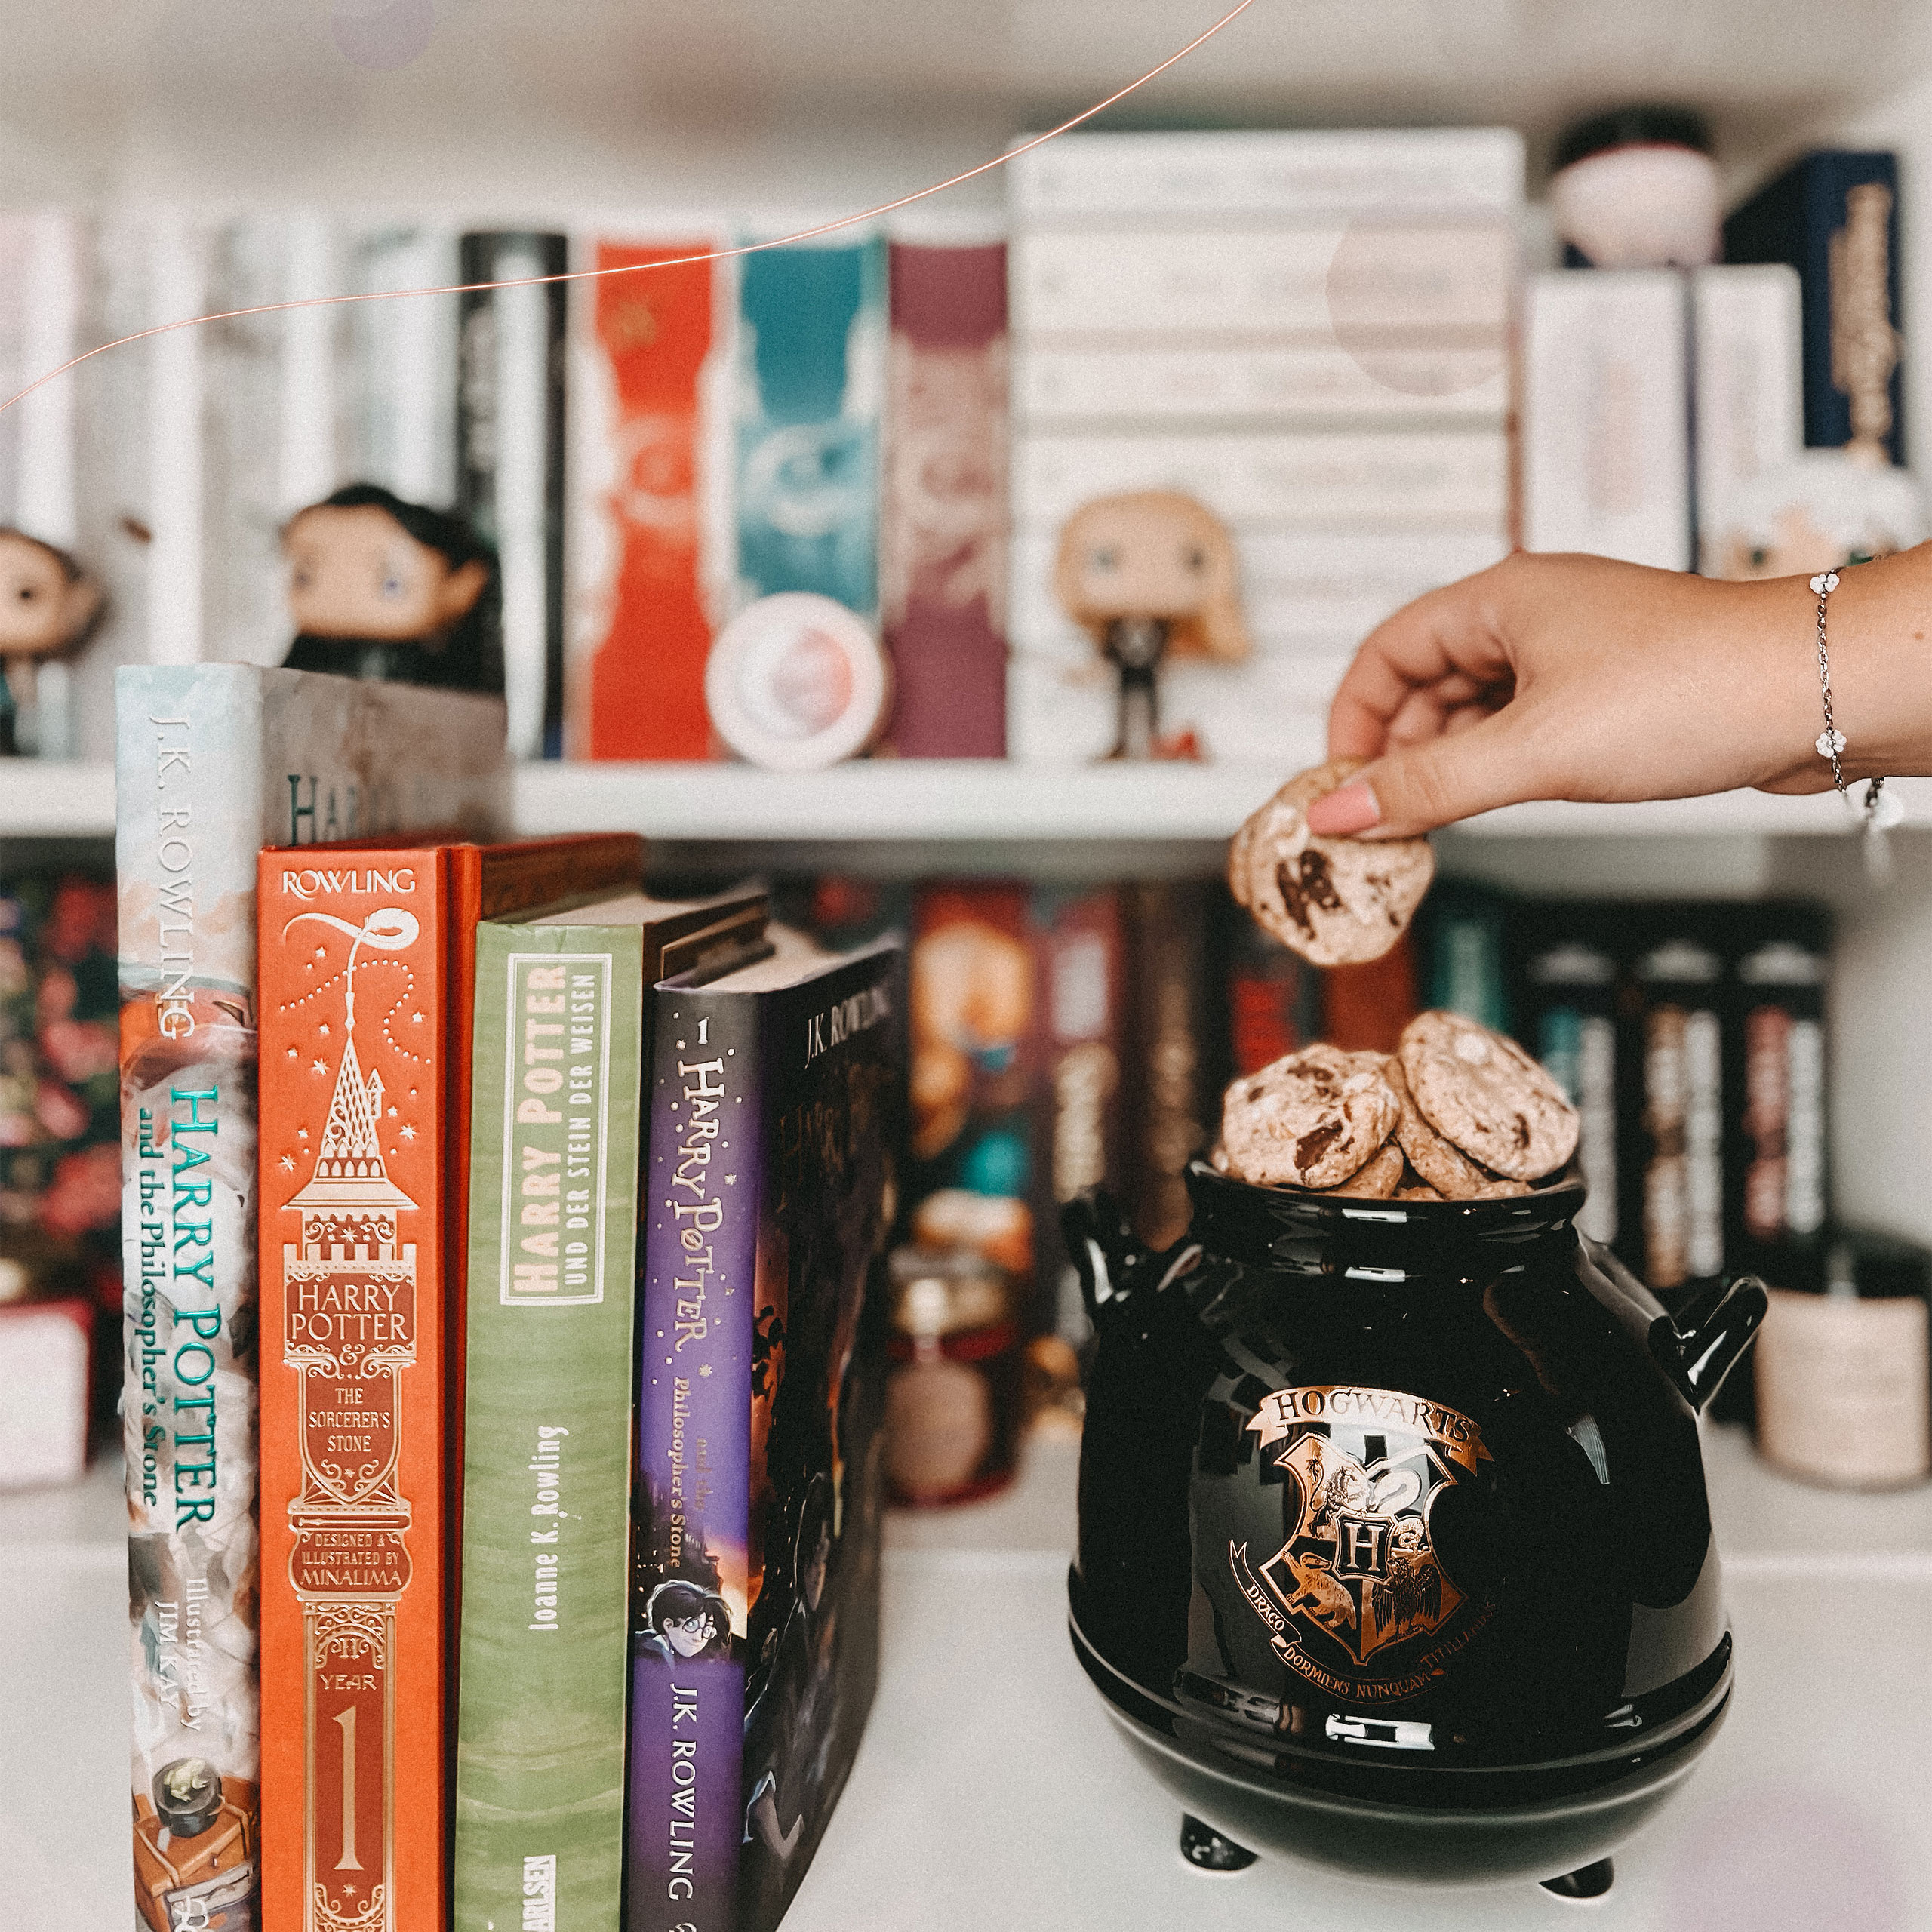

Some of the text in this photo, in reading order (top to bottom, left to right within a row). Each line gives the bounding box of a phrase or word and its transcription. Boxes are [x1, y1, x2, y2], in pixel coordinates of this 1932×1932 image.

[149, 714, 195, 1041] J.K. ROWLING
[282, 869, 416, 900] ROWLING
[696, 1017, 709, 1044] 1
[513, 965, 567, 1292] HARRY POTTER
[565, 974, 595, 1285] UND DER STEIN DER WEISEN
[672, 1057, 725, 1352] HARRY POTTER
[134, 1107, 167, 1507] and the Philosopher's Stone
[171, 1084, 222, 1534] HARRY POTTER
[291, 1313, 409, 1340] POTTER
[299, 1284, 401, 1311] HARRY
[339, 1343, 365, 1366] &
[308, 1411, 391, 1429] SORCERER'S
[334, 1388, 364, 1404] THE
[1272, 1389, 1473, 1442] HOGWARTS
[327, 1435, 371, 1452] STONE
[528, 1425, 570, 1516] Rowling
[667, 1376, 691, 1569] Philosopher's Stone
[694, 1438, 713, 1512] and the
[302, 1551, 399, 1565] ILLUSTRATED BY
[315, 1533, 373, 1547] DESIGNED
[529, 1521, 559, 1544] K.
[300, 1568, 403, 1586] MINALIMA
[154, 1601, 180, 1709] JIM KAY
[180, 1577, 209, 1732] Illustrated by
[1247, 1584, 1284, 1631] DRACO
[1283, 1645, 1351, 1696] DORMIENS
[1356, 1672, 1432, 1698] NUNQUAM
[319, 1674, 377, 1690] YEAR
[332, 1705, 365, 1871] 1
[667, 1682, 698, 1901] J.K. ROWLING
[522, 1855, 551, 1932] ARLSEN
